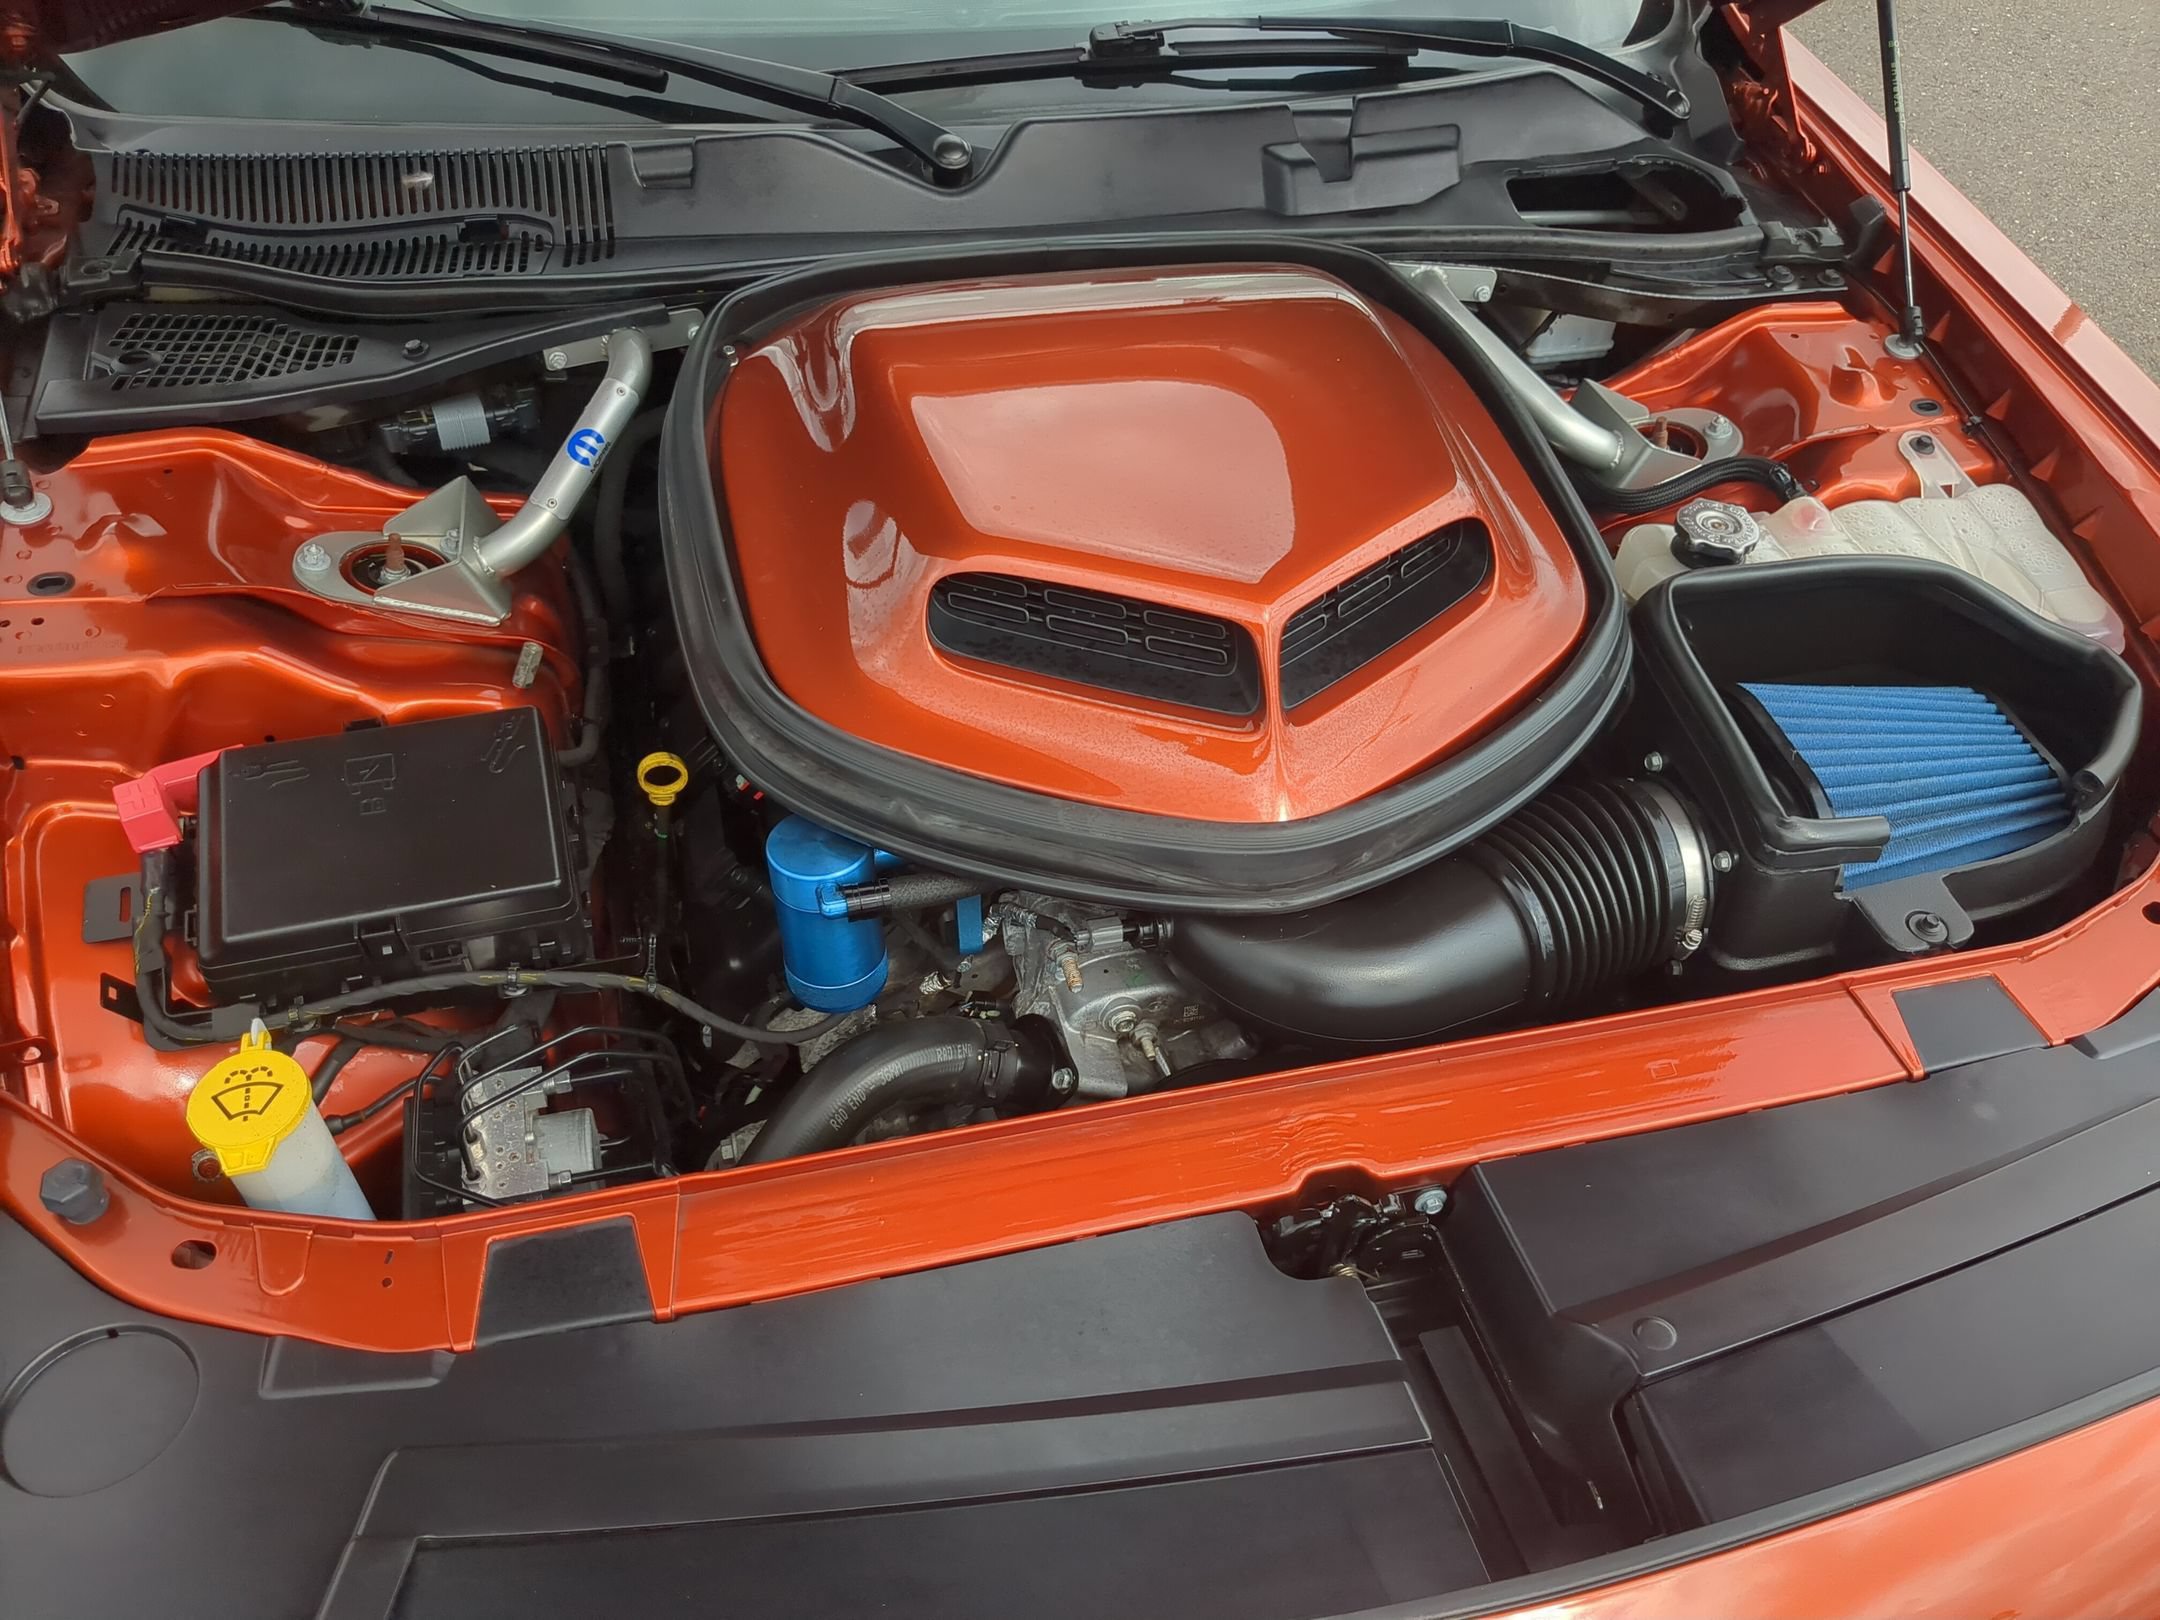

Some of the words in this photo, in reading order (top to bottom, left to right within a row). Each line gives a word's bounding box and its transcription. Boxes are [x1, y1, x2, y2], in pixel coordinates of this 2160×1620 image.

[936, 1046, 953, 1063] RAD
[829, 1108, 848, 1131] RAD
[847, 1087, 867, 1111] END
